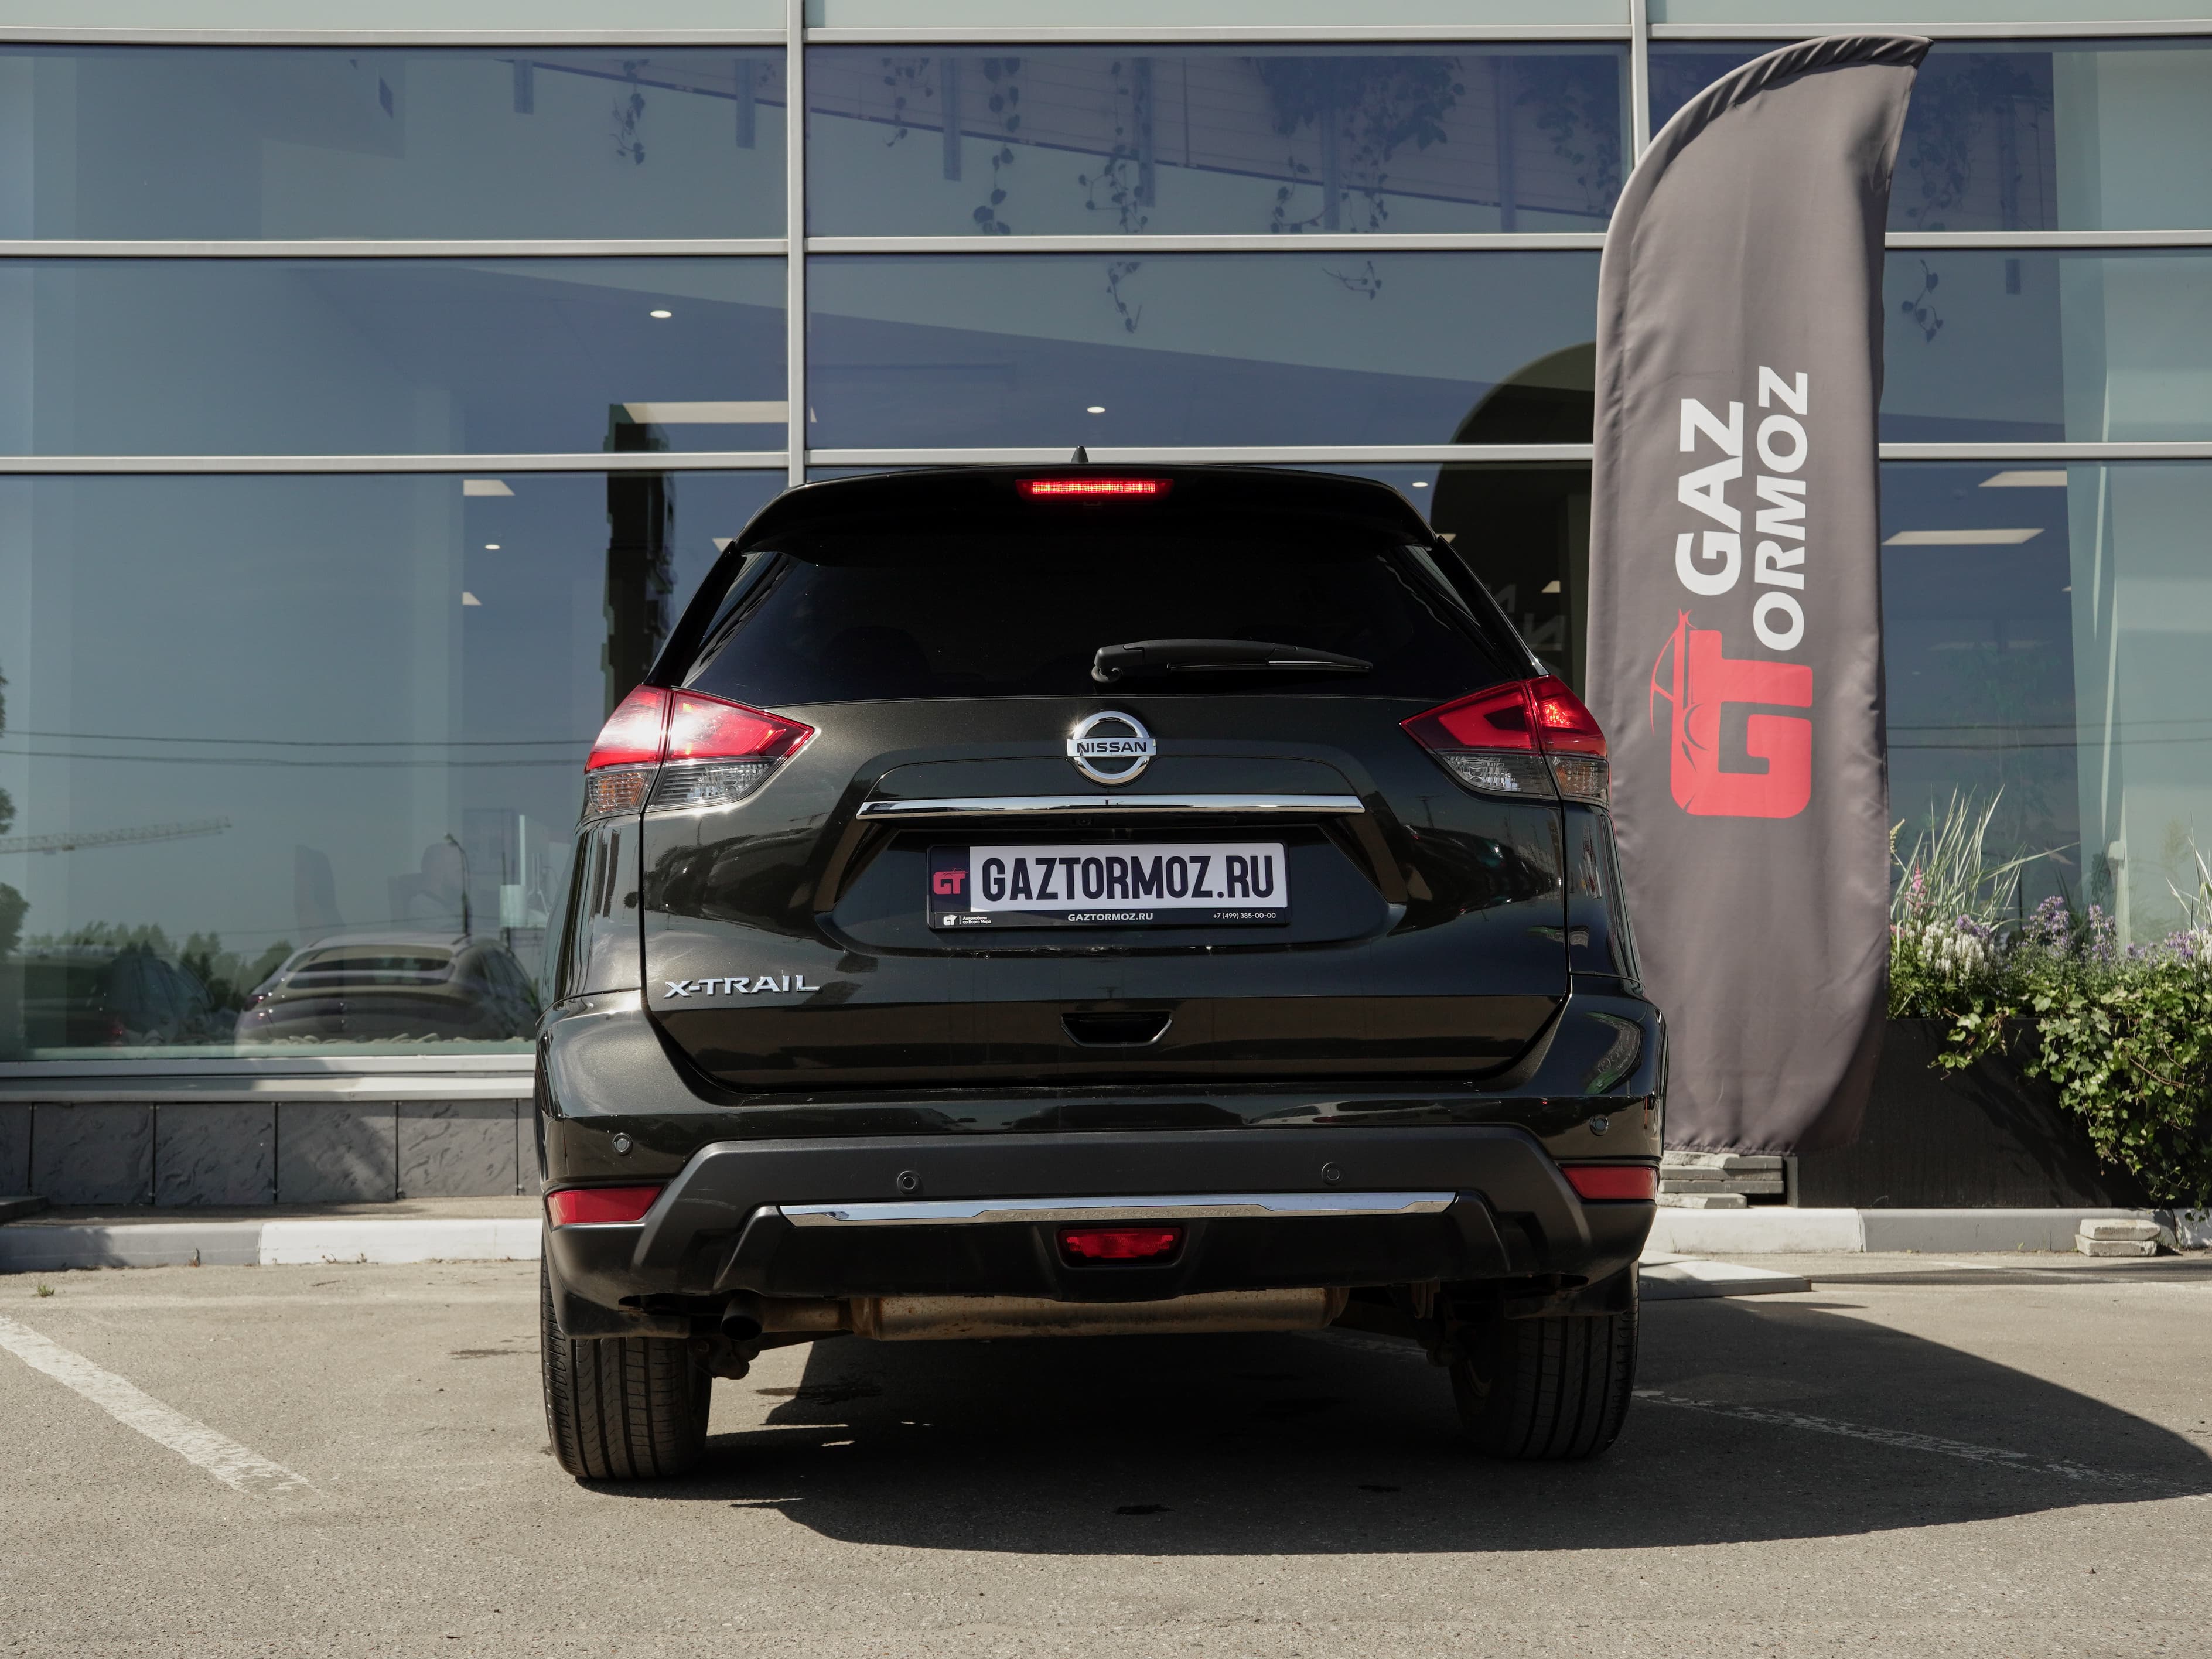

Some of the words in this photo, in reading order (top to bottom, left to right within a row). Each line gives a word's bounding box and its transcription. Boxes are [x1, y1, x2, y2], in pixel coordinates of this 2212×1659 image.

[1675, 398, 1744, 596] GAZ
[1077, 742, 1146, 753] NISSAN
[933, 867, 968, 895] GT
[982, 855, 1274, 902] GAZTORMOZ.RU
[1067, 913, 1153, 921] GAZTORMOZ.RU
[663, 975, 820, 998] X-TRAIL
